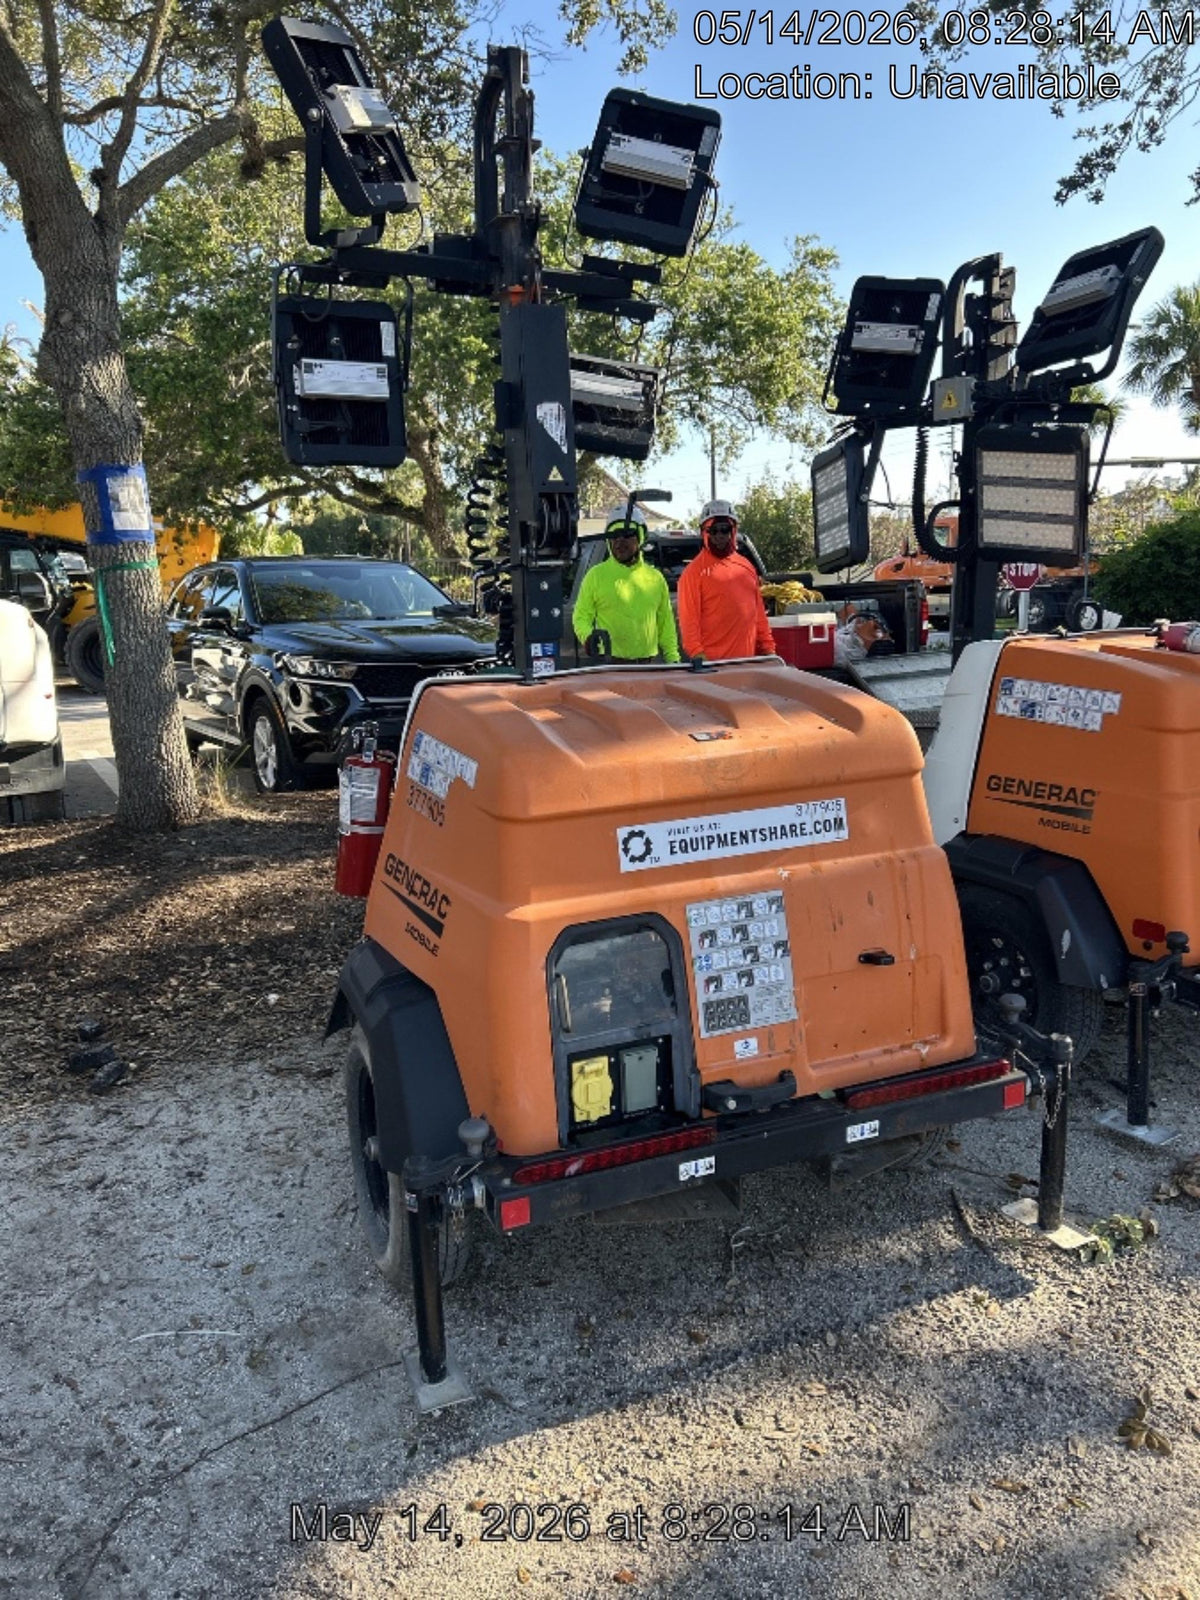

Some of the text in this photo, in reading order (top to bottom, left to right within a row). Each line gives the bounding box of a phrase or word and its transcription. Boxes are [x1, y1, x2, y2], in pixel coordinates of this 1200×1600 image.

[1009, 562, 1037, 577] STOP
[986, 774, 1096, 807] GENERAC
[667, 822, 721, 837] VISIT US AT:
[669, 817, 845, 856] EQUIPMENTSHARE.COM
[1038, 817, 1091, 834] MOBILE
[650, 856, 661, 864] TM
[384, 853, 451, 920] GENERAC
[405, 922, 440, 957] MOBILE
